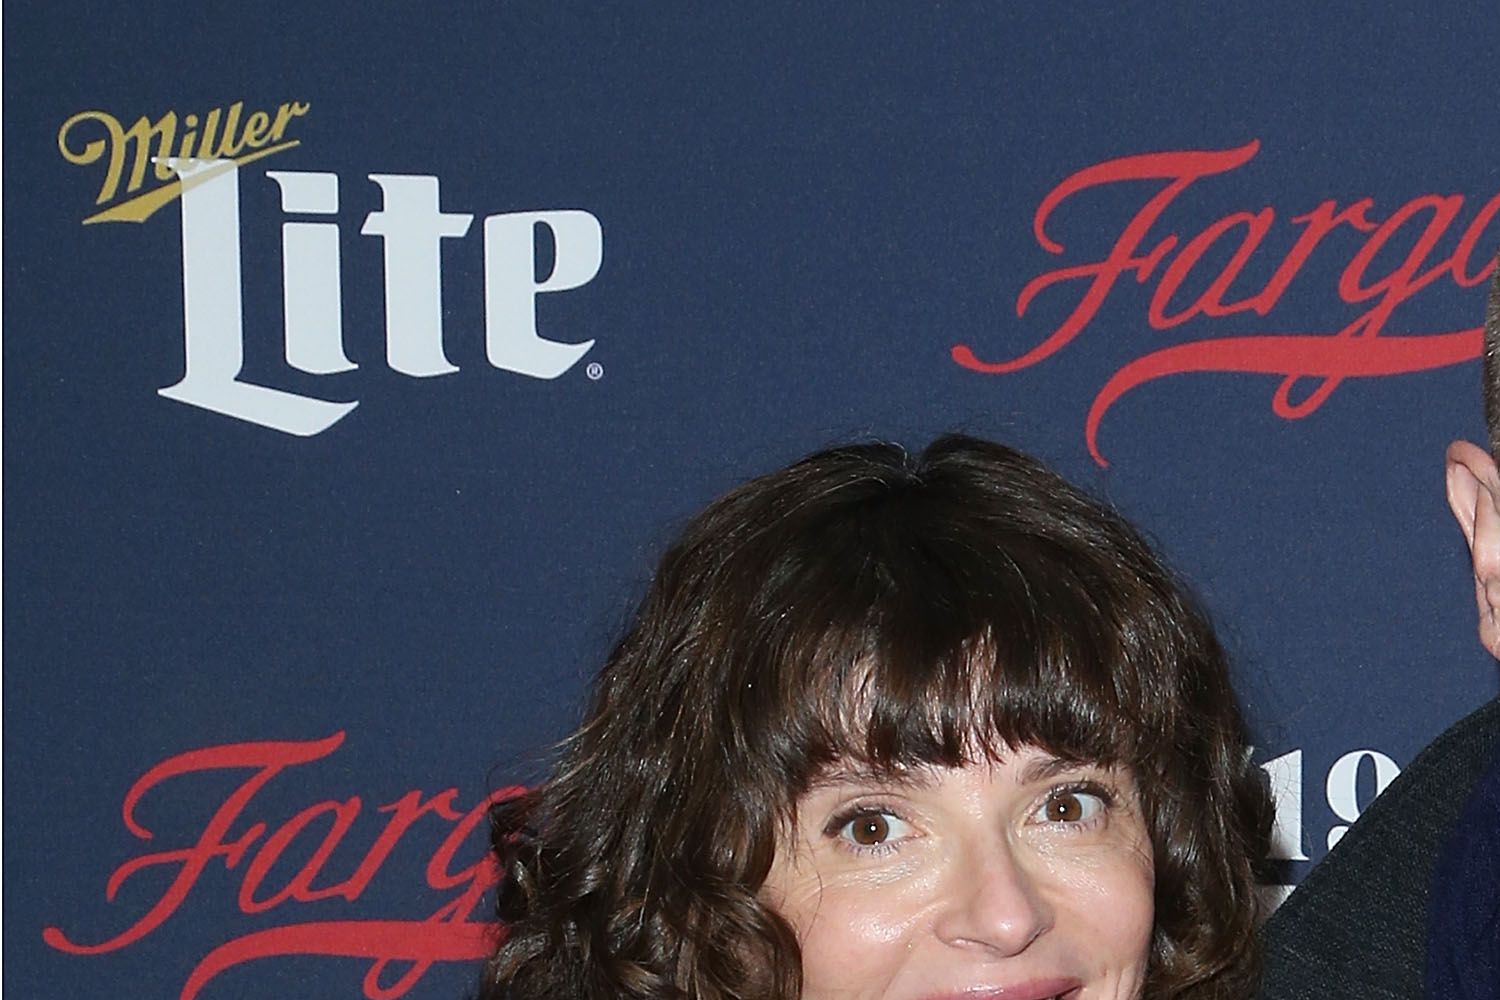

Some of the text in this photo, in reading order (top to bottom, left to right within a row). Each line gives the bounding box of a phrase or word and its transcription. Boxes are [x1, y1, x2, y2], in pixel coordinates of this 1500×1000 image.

[58, 101, 310, 222] Miller
[151, 157, 604, 437] Lite
[1246, 746, 1402, 861] 19
